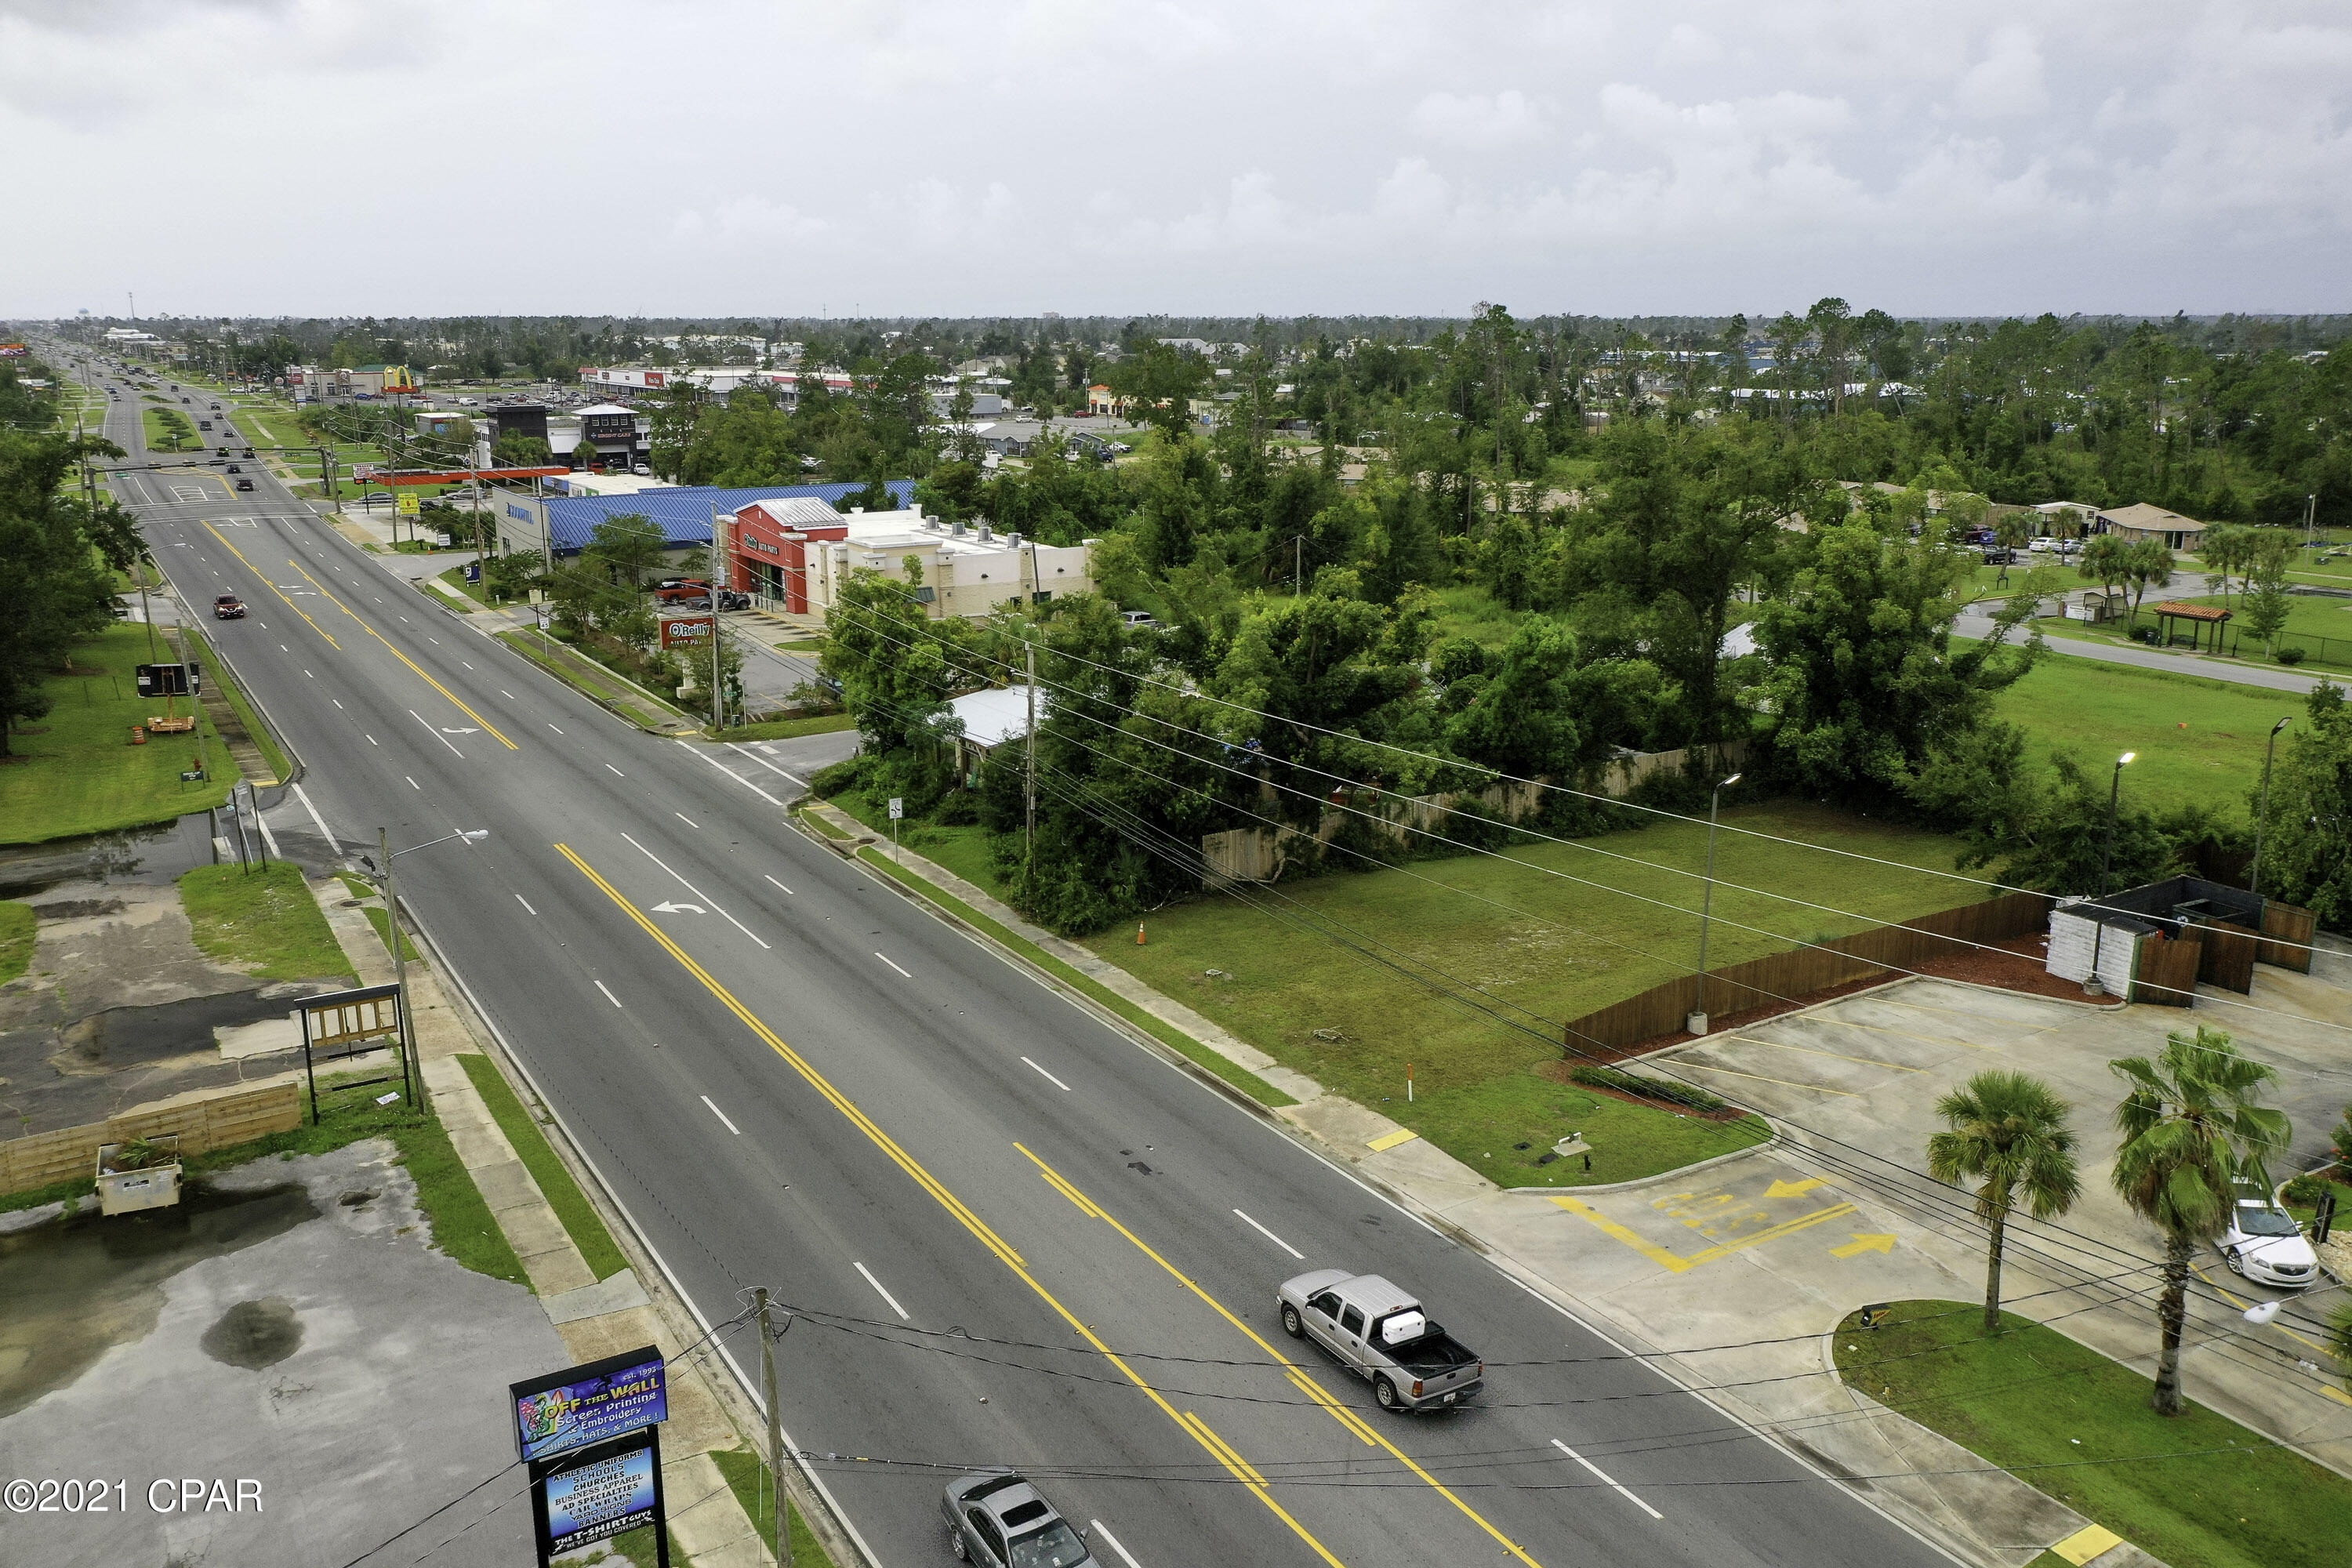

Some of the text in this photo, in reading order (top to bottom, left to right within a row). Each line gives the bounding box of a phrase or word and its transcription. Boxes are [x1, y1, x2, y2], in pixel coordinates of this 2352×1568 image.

[670, 622, 710, 637] O'Reilly
[545, 1377, 661, 1418] OFF THE WALL
[581, 1406, 641, 1430] Embroidery
[613, 1423, 622, 1432] &
[625, 1414, 652, 1428] MORE
[552, 1450, 644, 1483] ATHLETIC UNIFORMS
[573, 1462, 625, 1484] SCHOOLS
[555, 1473, 644, 1506] BUSINESS APPAREL
[573, 1471, 625, 1492] CHURCHES
[561, 1482, 639, 1512] AD SPECIALTIES
[569, 1491, 632, 1516] CAR WRAPS
[572, 1498, 632, 1522] YARD SIGNS
[578, 1507, 626, 1529] BANNERS
[554, 1509, 652, 1545] THE T-SHIRT GUYS
[586, 1534, 599, 1543] GOT
[600, 1529, 612, 1537] YOU
